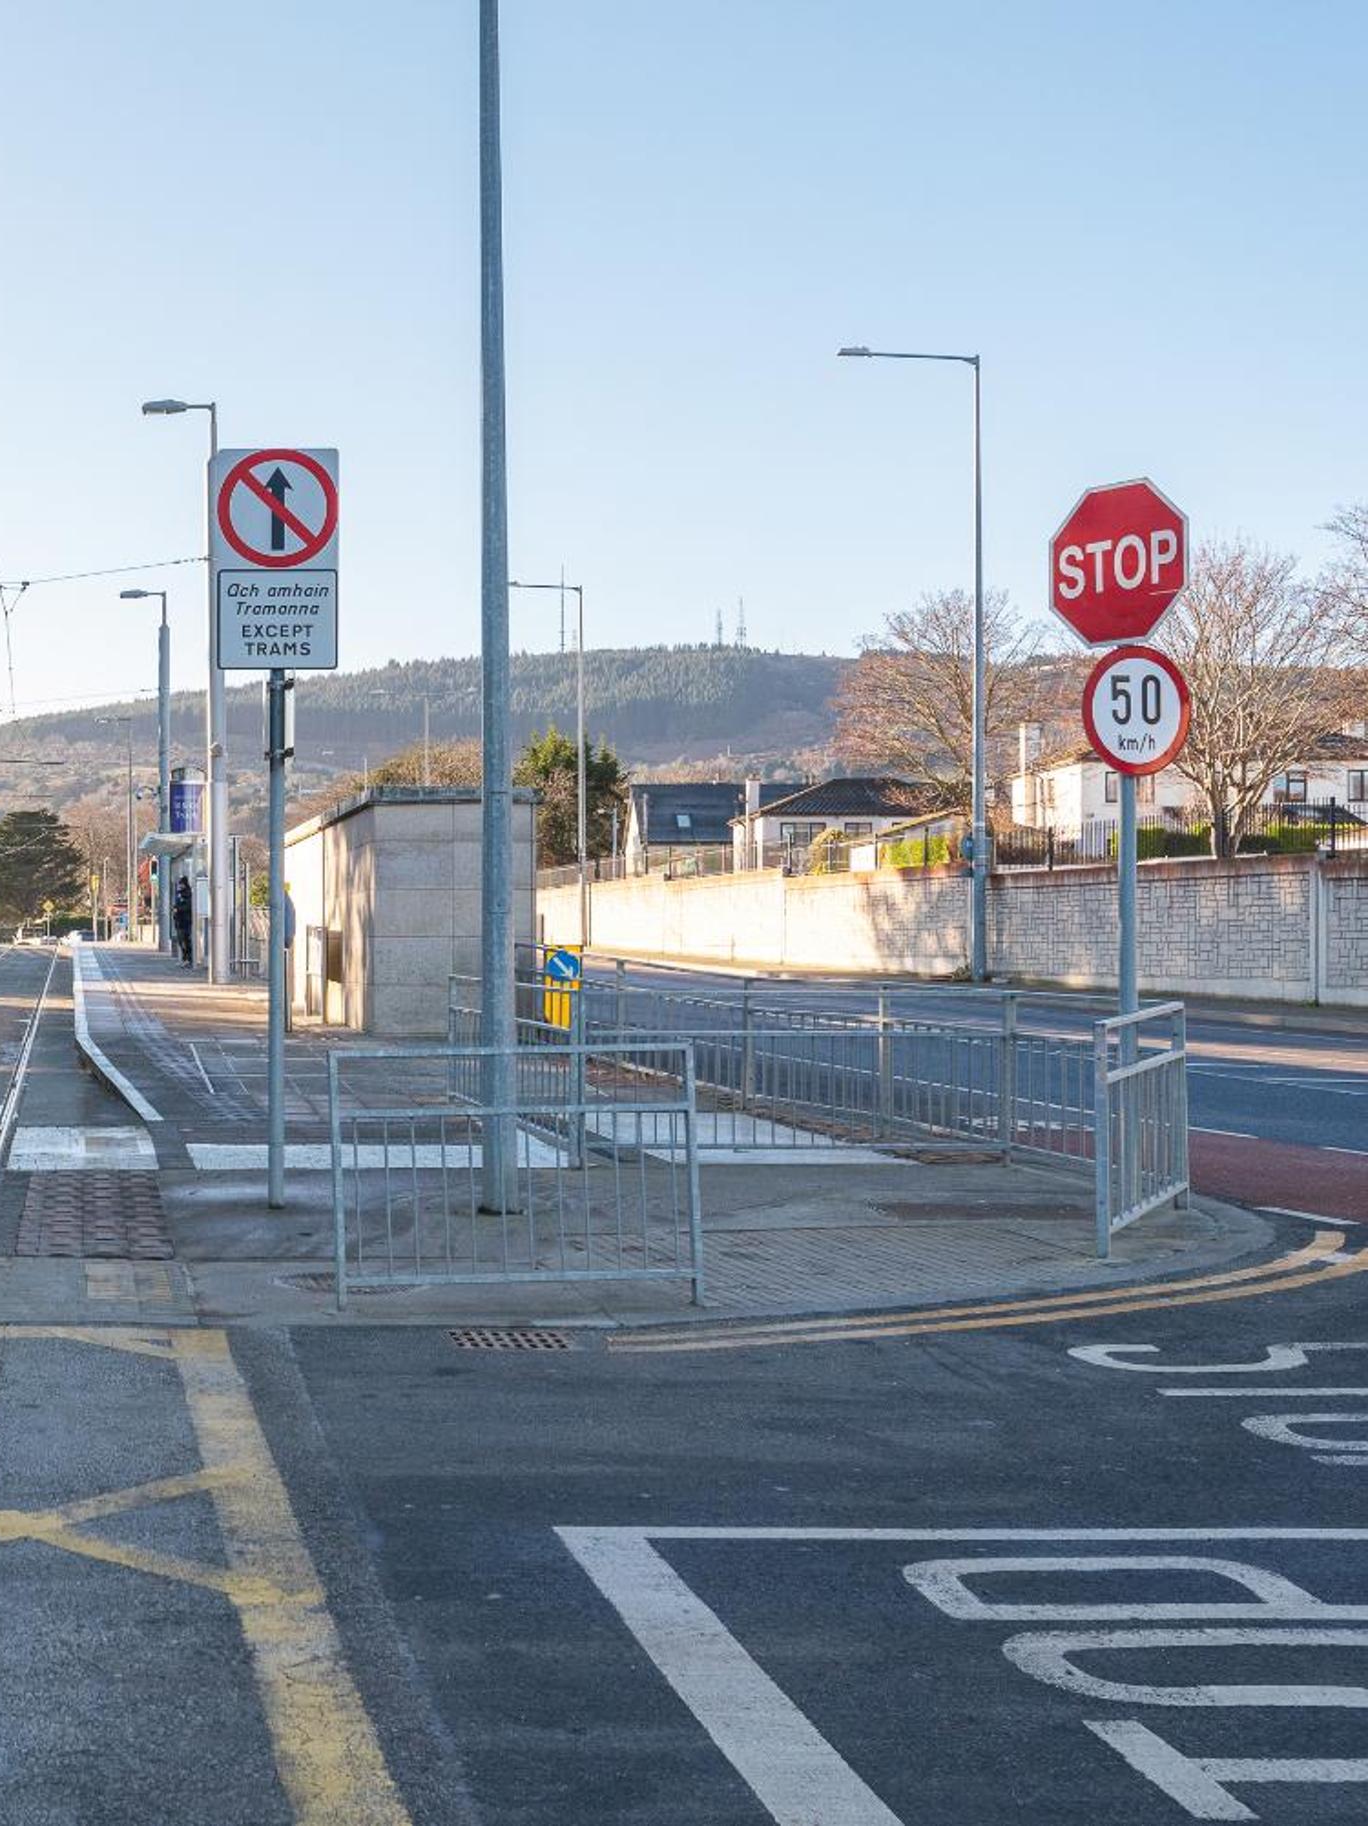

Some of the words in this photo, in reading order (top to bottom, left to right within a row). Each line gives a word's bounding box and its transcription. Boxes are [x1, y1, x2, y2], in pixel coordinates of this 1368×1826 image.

[1058, 529, 1177, 600] STOP
[236, 601, 320, 616] Tramanna
[242, 624, 314, 638] EXCEPT
[244, 641, 312, 656] TRAMS
[1110, 674, 1162, 725] 50
[1117, 732, 1157, 752] km/h
